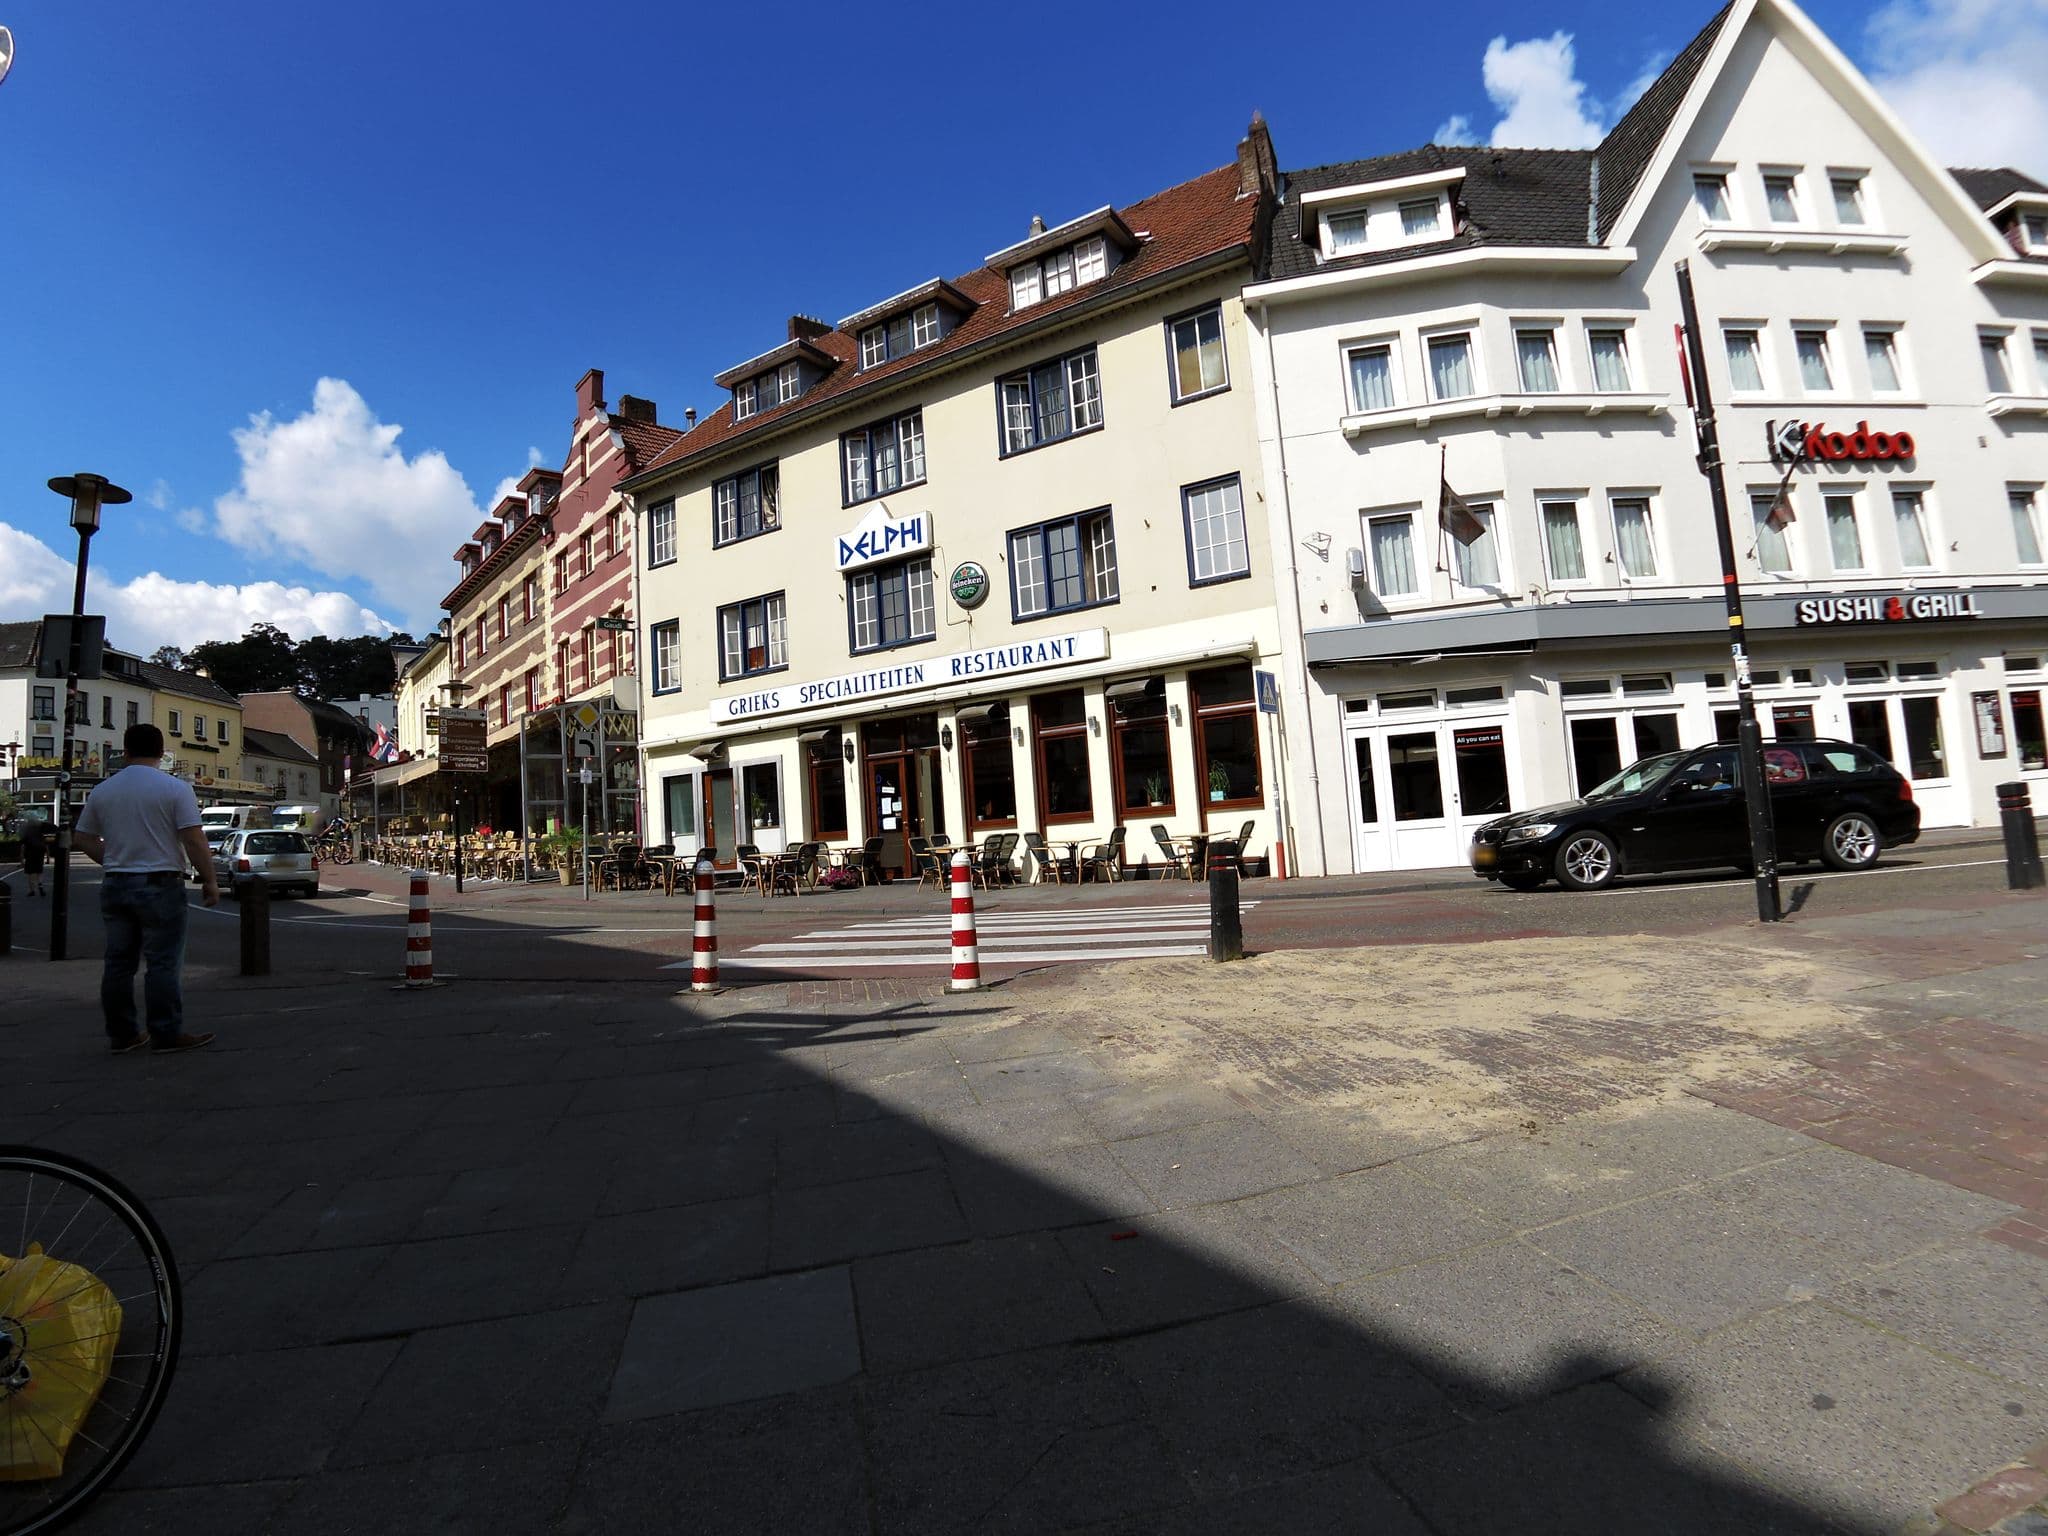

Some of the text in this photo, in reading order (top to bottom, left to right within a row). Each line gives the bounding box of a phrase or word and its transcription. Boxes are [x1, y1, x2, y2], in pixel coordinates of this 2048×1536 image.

[1802, 421, 1915, 460] Kodoo
[839, 517, 922, 566] DELPHI
[952, 576, 983, 590] Heineken
[1799, 594, 1984, 623] SUSHI & GRILL
[729, 637, 1076, 715] GRIEKS SPECIALITEITEN RESTAURANT
